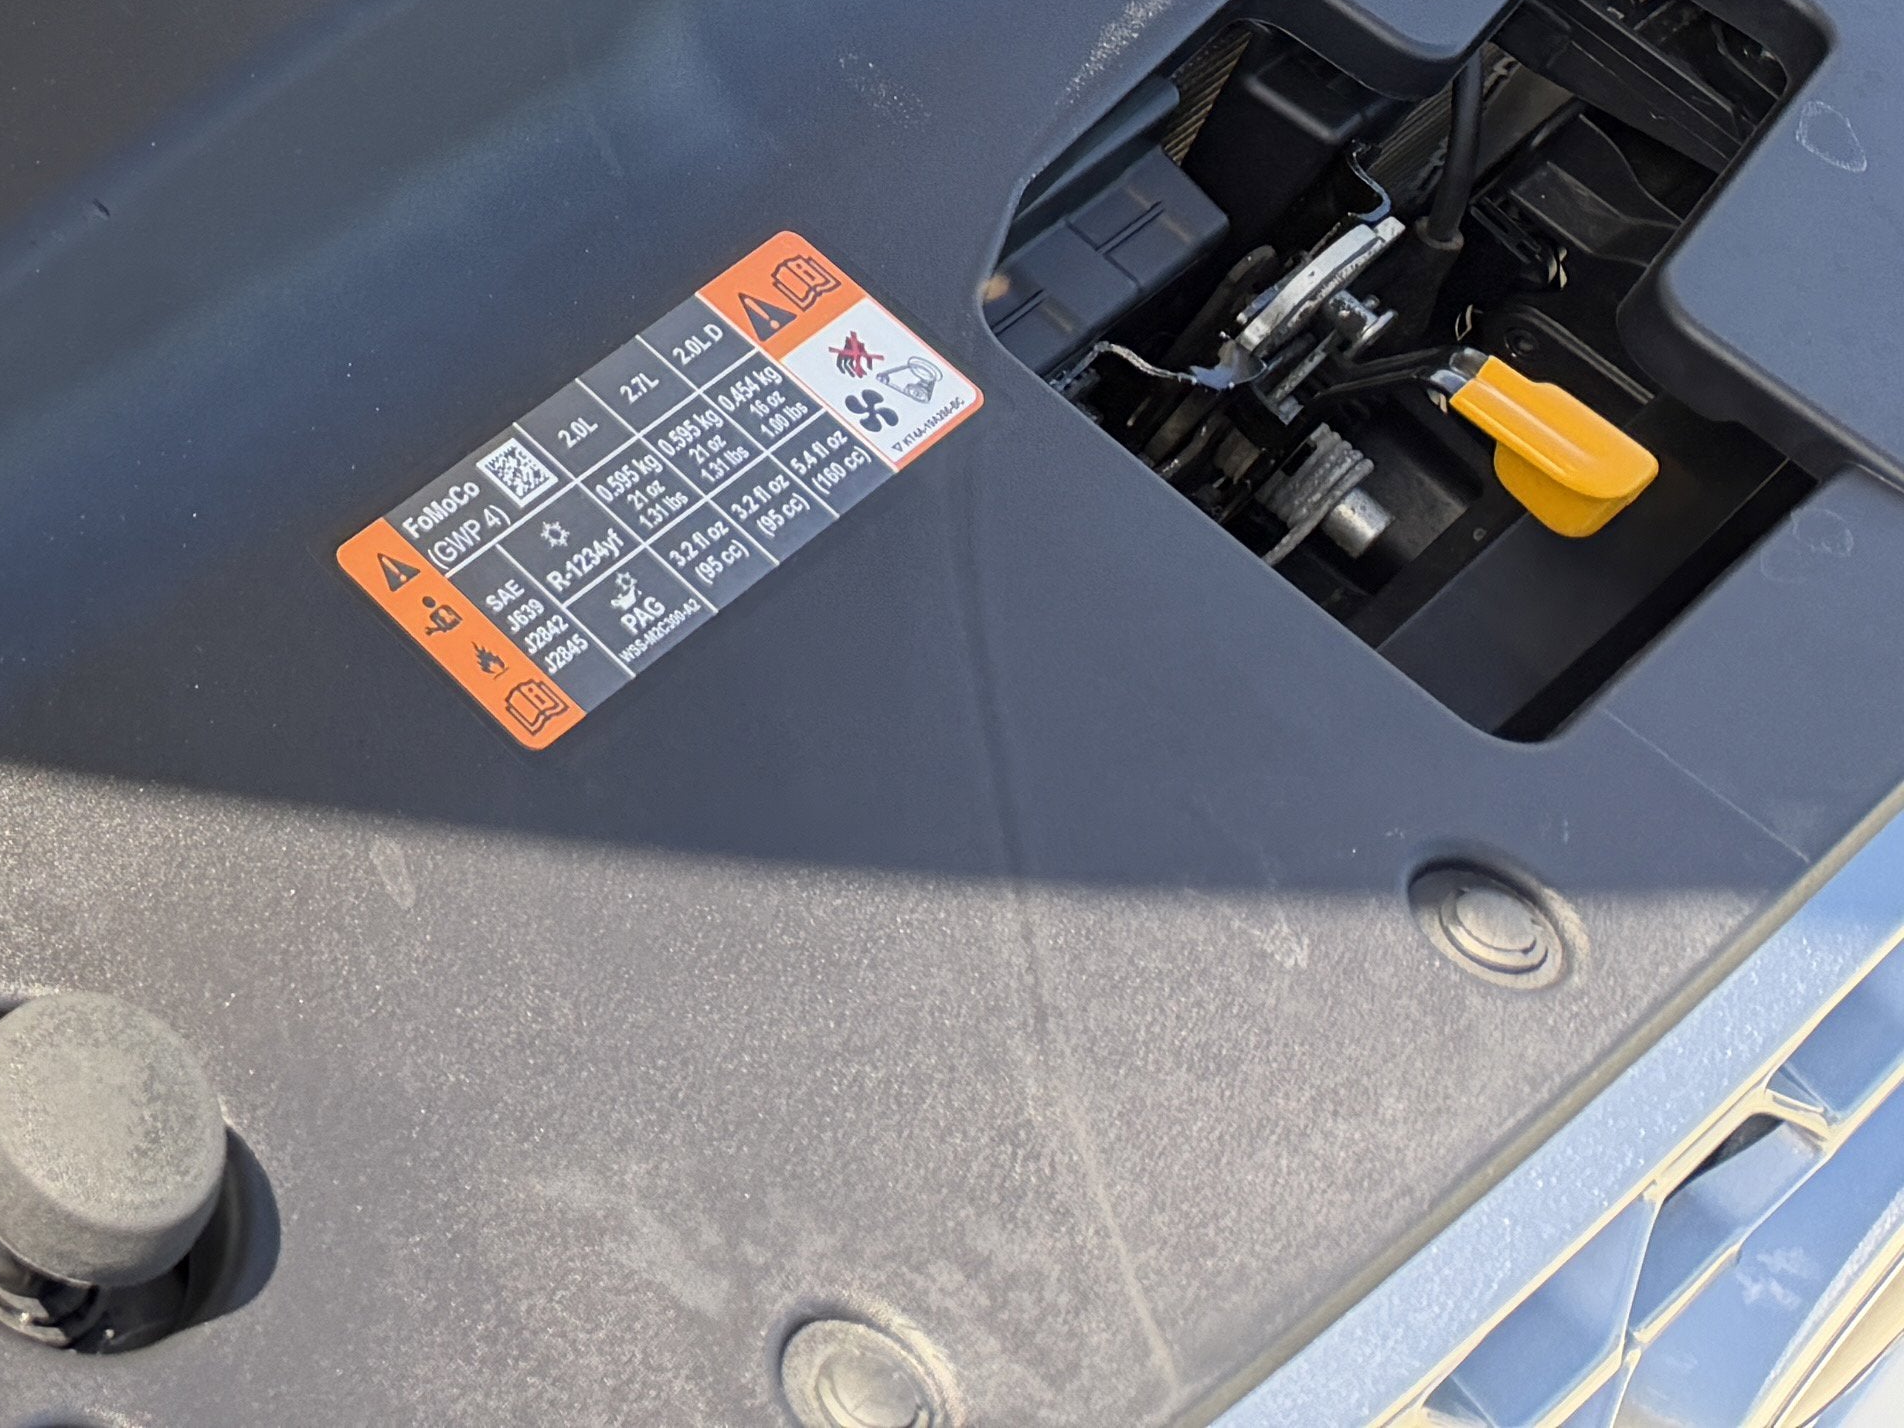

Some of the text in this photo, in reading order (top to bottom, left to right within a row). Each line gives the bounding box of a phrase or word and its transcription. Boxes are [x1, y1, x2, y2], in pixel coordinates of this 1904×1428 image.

[672, 323, 724, 366] 2.0L D
[620, 372, 659, 405] 2.7L
[718, 365, 784, 412] 0.454 kg
[750, 390, 787, 419] 16 oz
[557, 417, 598, 449] 2.0L
[657, 407, 725, 457] 0.595 kg
[760, 401, 809, 439] 1.00 lbs
[688, 434, 727, 465] 21 oz
[700, 446, 750, 484] 1.31 lbs
[791, 429, 848, 477] 5.4 fl oz
[595, 453, 664, 503] 0.595 kg
[811, 446, 872, 495] (160 cc)
[402, 481, 480, 538] FoMoCo
[627, 479, 667, 511] 21 oz
[638, 491, 689, 530] 1.31 lbs
[731, 474, 790, 521] 3.2 fl oz
[756, 492, 811, 538] (95 cc)
[428, 504, 512, 570] (GWP 4)
[669, 520, 730, 569] 3.2 fl oz
[547, 528, 624, 592] R-1234yf
[694, 539, 749, 585] (95 cc)
[485, 579, 525, 613] SAE
[508, 598, 545, 634] J639
[621, 595, 666, 635] PAG
[526, 615, 570, 655] J2842
[546, 634, 589, 674] J2845
